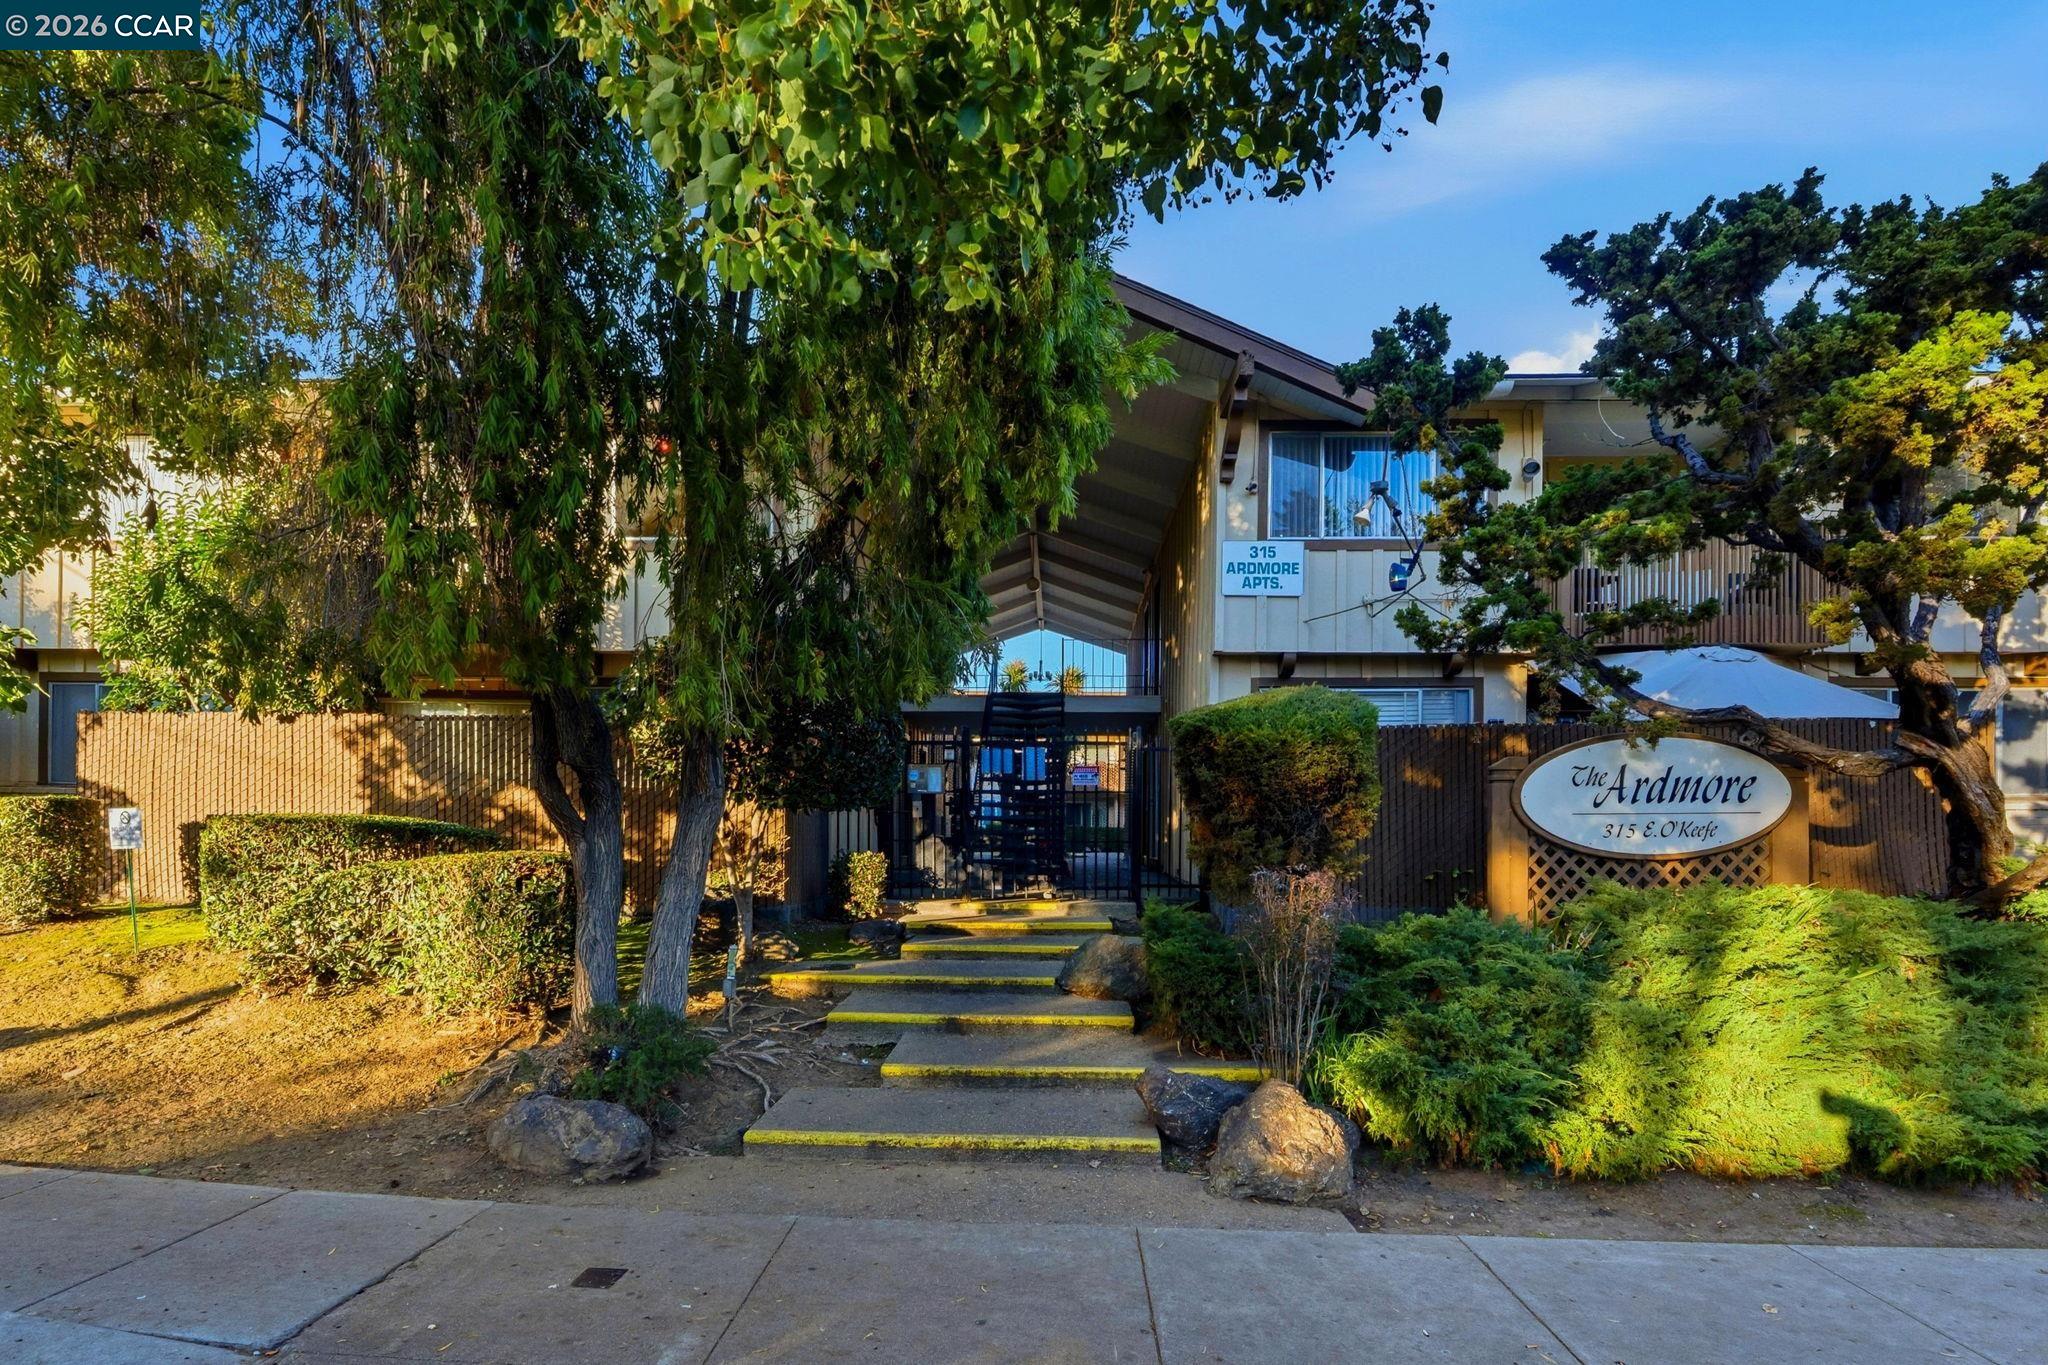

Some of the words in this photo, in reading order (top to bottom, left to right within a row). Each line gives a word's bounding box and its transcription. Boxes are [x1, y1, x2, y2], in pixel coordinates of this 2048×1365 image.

[1249, 546, 1276, 559] 315
[1226, 562, 1300, 575] ARDMORE
[1241, 576, 1283, 589] APTS.
[1571, 765, 1609, 787] The
[1592, 763, 1758, 809] Ardmore
[1602, 823, 1637, 839] 315
